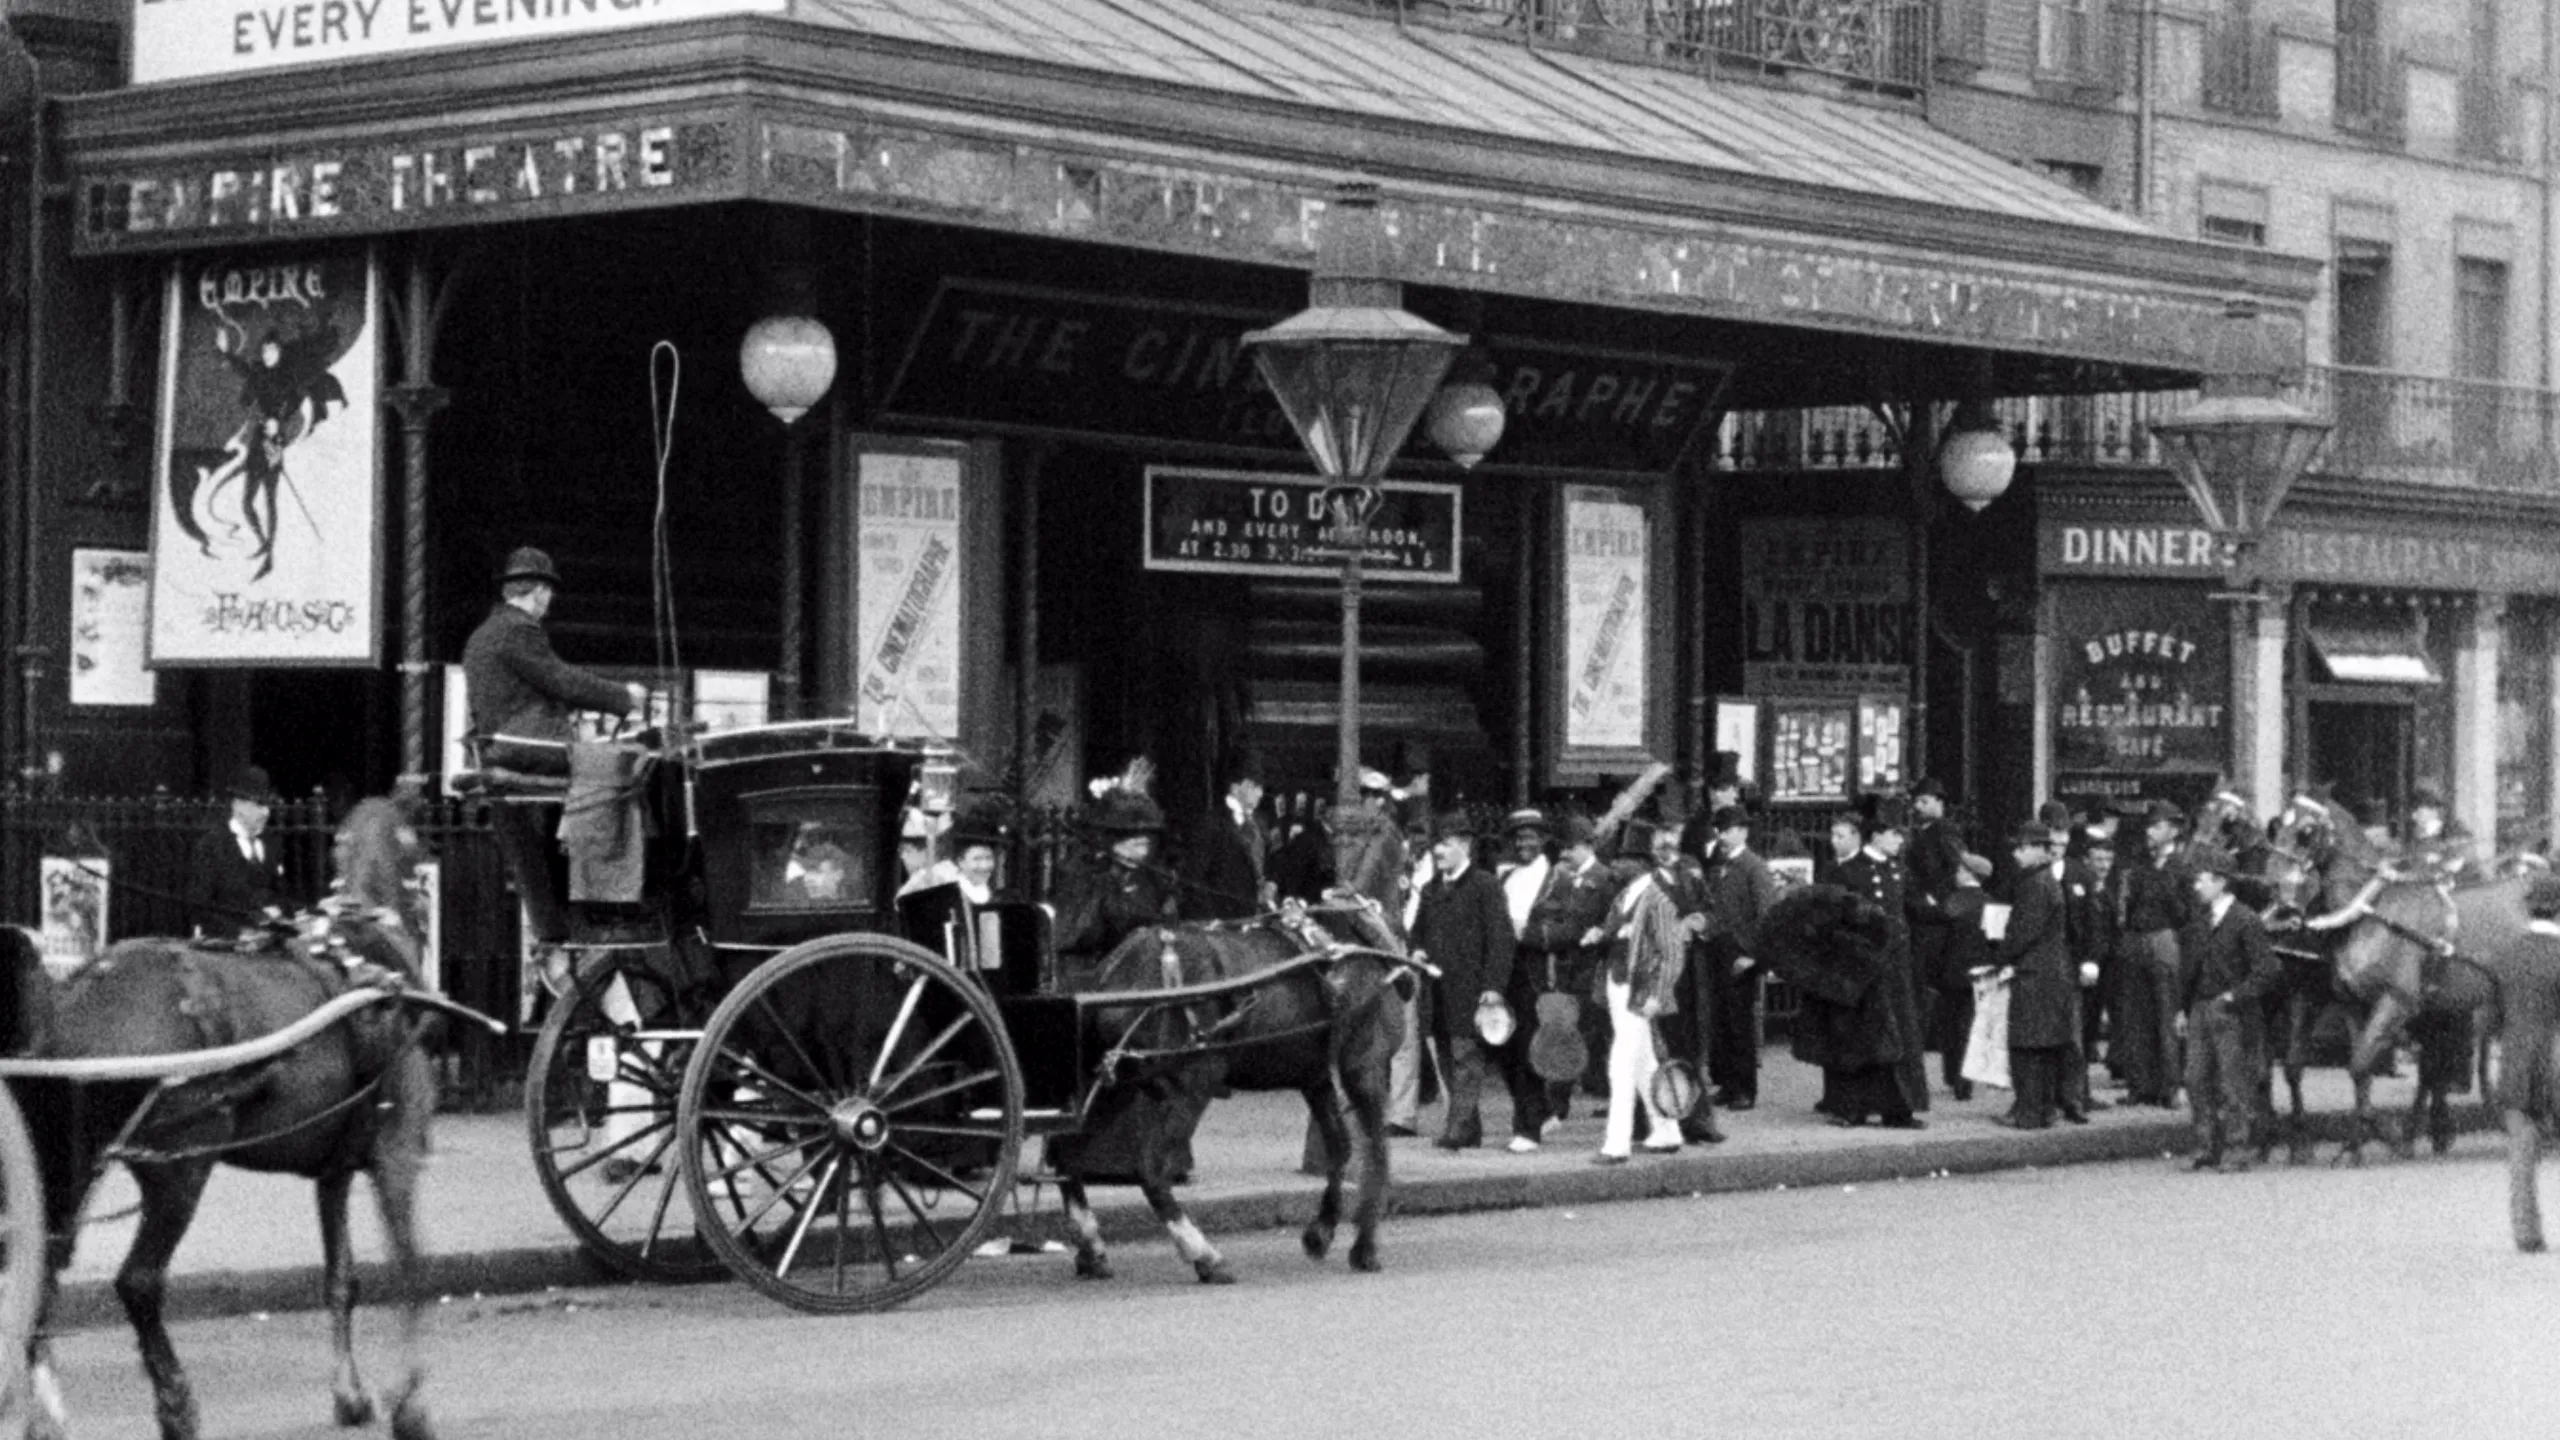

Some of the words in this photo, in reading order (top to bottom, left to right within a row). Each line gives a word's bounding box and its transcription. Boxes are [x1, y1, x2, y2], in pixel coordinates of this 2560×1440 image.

[234, 0, 382, 54] EVERY
[953, 310, 1091, 374] THE
[1123, 328, 1697, 427] CINRAPHE
[1250, 488, 1289, 519] TO
[1190, 519, 1228, 536] AND
[1244, 521, 1299, 539] EVERY
[1179, 540, 1199, 556] AT
[2279, 529, 2480, 586] RESTAURANT
[1746, 600, 1791, 662] LA
[1803, 602, 1914, 664] DANSE
[2086, 631, 2196, 663] BUFFET
[2061, 700, 2222, 727] RESTAURANT
